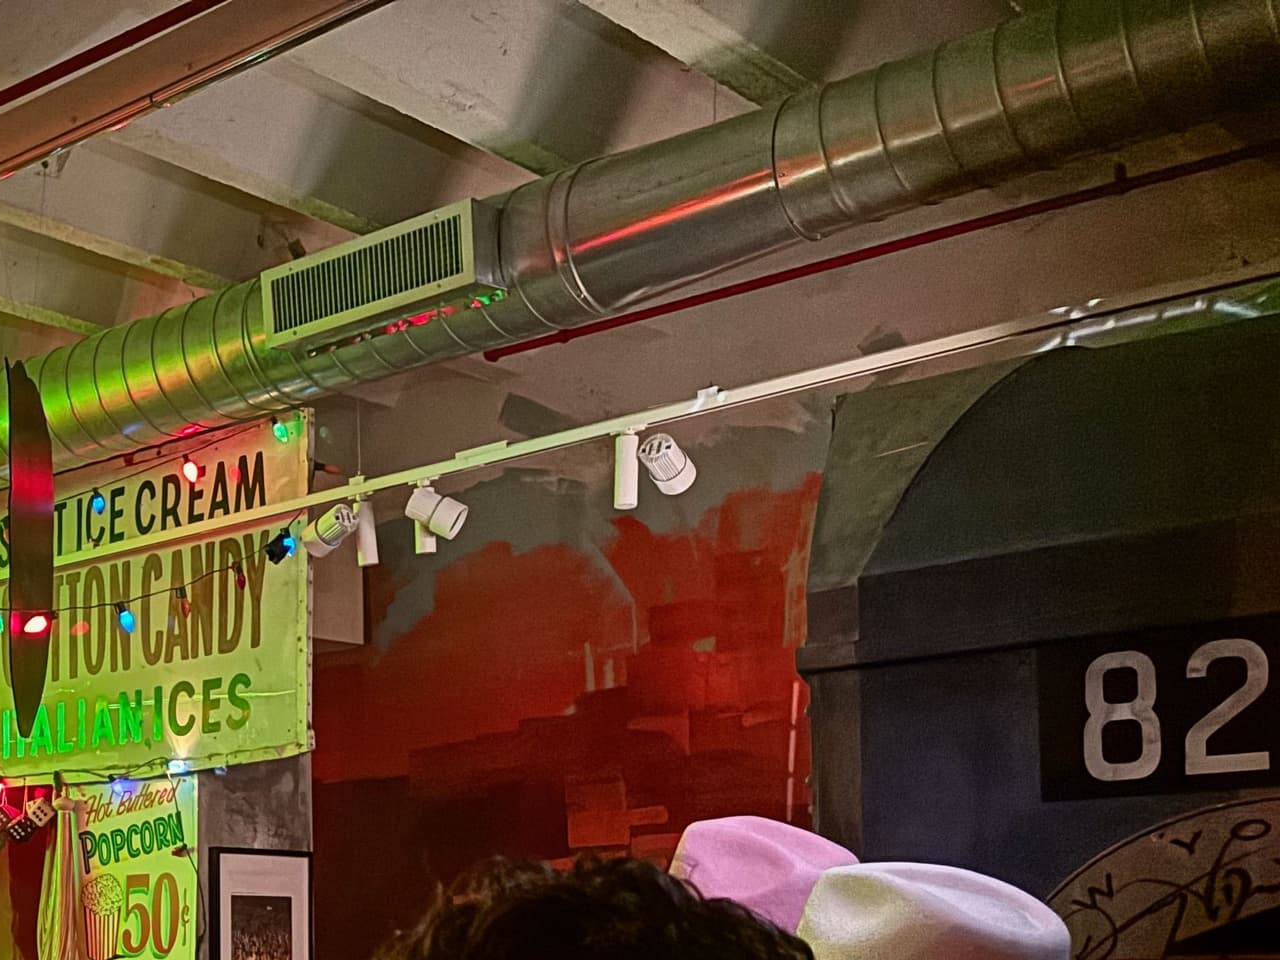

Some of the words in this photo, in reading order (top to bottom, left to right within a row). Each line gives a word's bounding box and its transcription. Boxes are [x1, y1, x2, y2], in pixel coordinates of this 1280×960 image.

[76, 487, 125, 552] ICE
[135, 451, 267, 535] CREAM
[1, 559, 132, 689] TTON
[141, 530, 270, 667] CANDY
[153, 673, 252, 742] ICES
[1083, 638, 1270, 782] 82
[79, 811, 184, 875] POPCORN
[84, 793, 113, 827] Hot
[116, 783, 180, 817] Buttered
